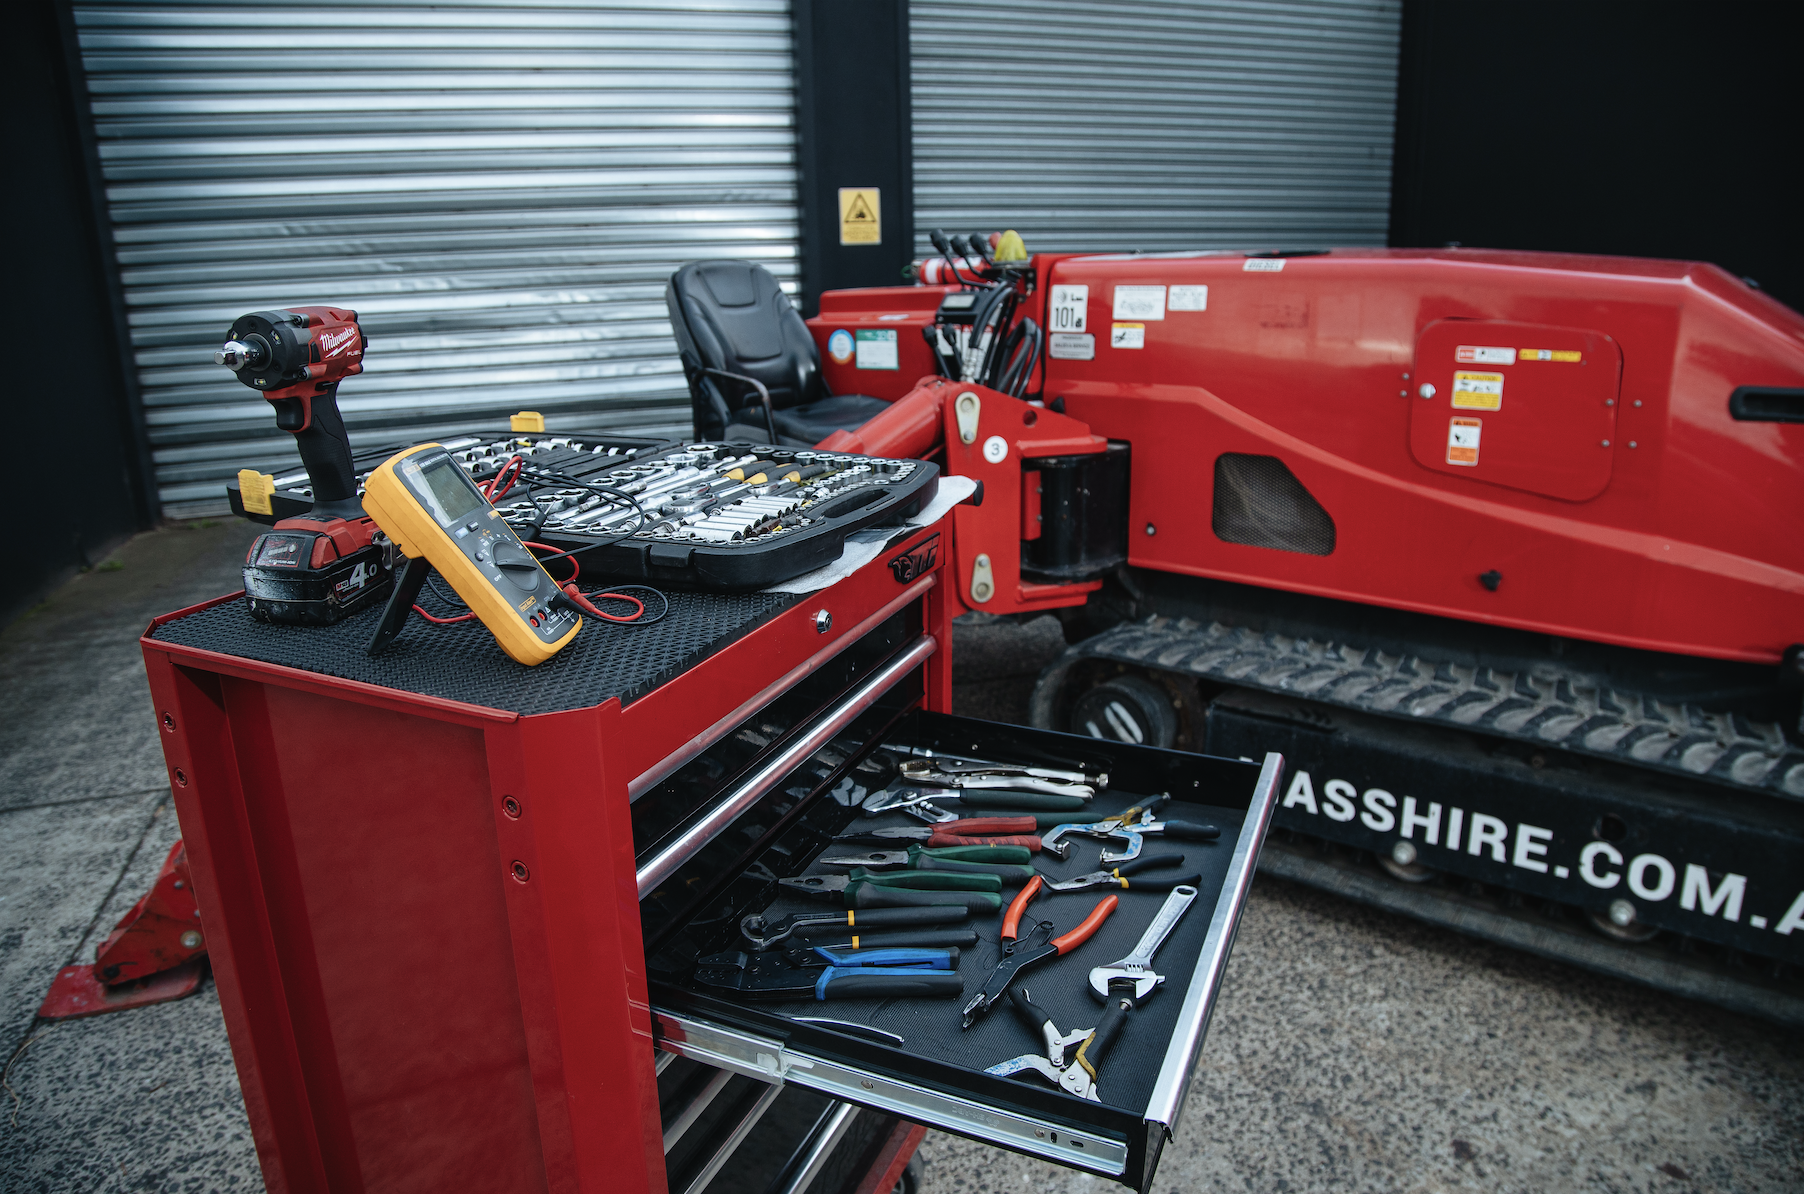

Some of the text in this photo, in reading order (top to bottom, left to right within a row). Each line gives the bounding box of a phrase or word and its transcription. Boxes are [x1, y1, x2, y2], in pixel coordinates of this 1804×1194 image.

[1055, 307, 1074, 328] 101
[319, 327, 356, 352] Milwaukee
[991, 443, 1000, 456] 3
[350, 561, 378, 588] 4.0
[1275, 770, 1804, 936] ASSHIRE.COM.A
